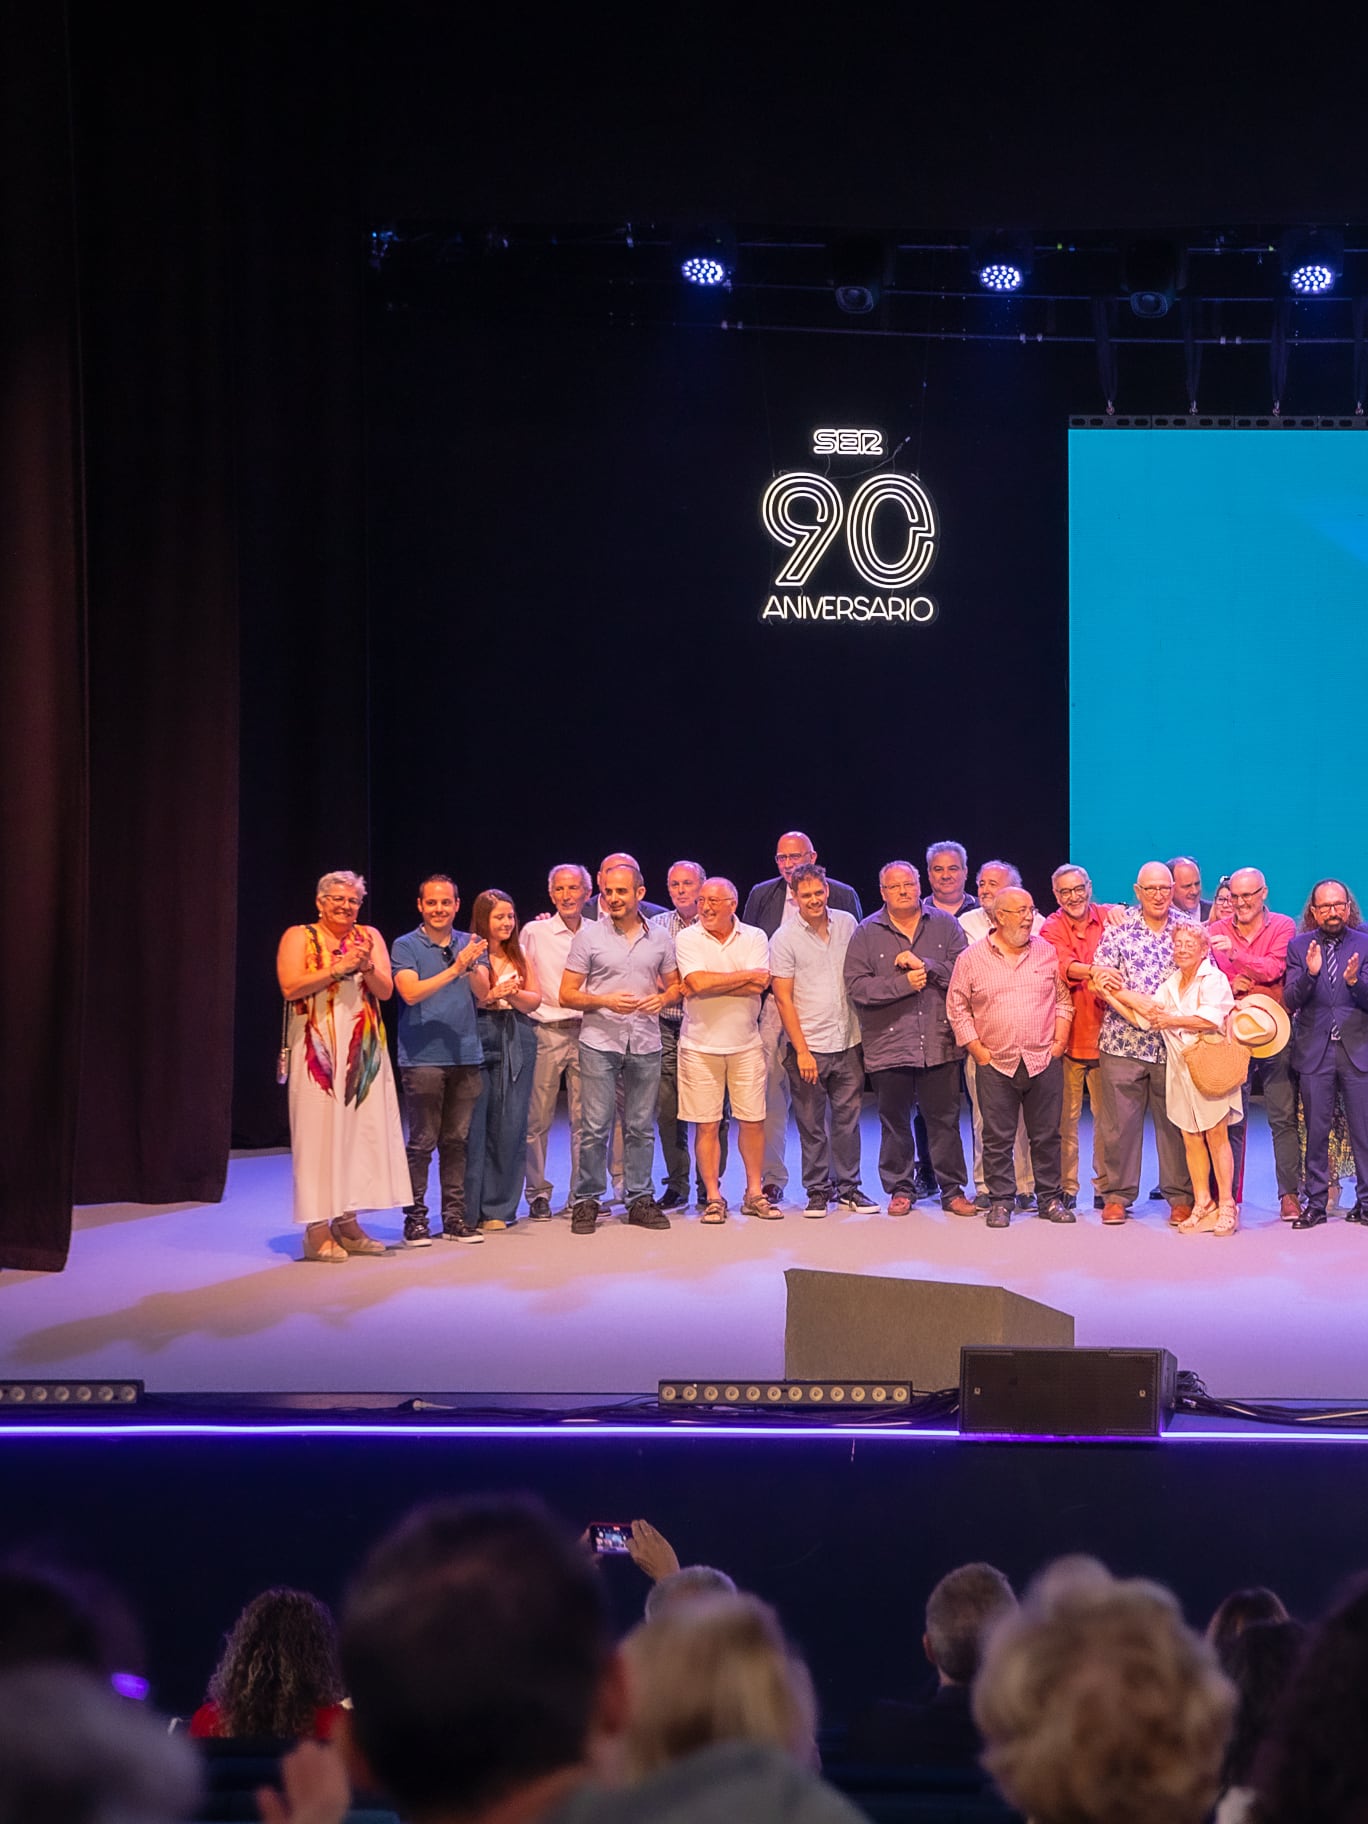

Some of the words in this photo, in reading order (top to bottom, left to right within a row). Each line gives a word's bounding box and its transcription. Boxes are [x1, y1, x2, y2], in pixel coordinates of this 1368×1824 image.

[812, 428, 884, 455] SER
[762, 471, 937, 589] 90
[761, 594, 935, 622] ANIVERSARIO
